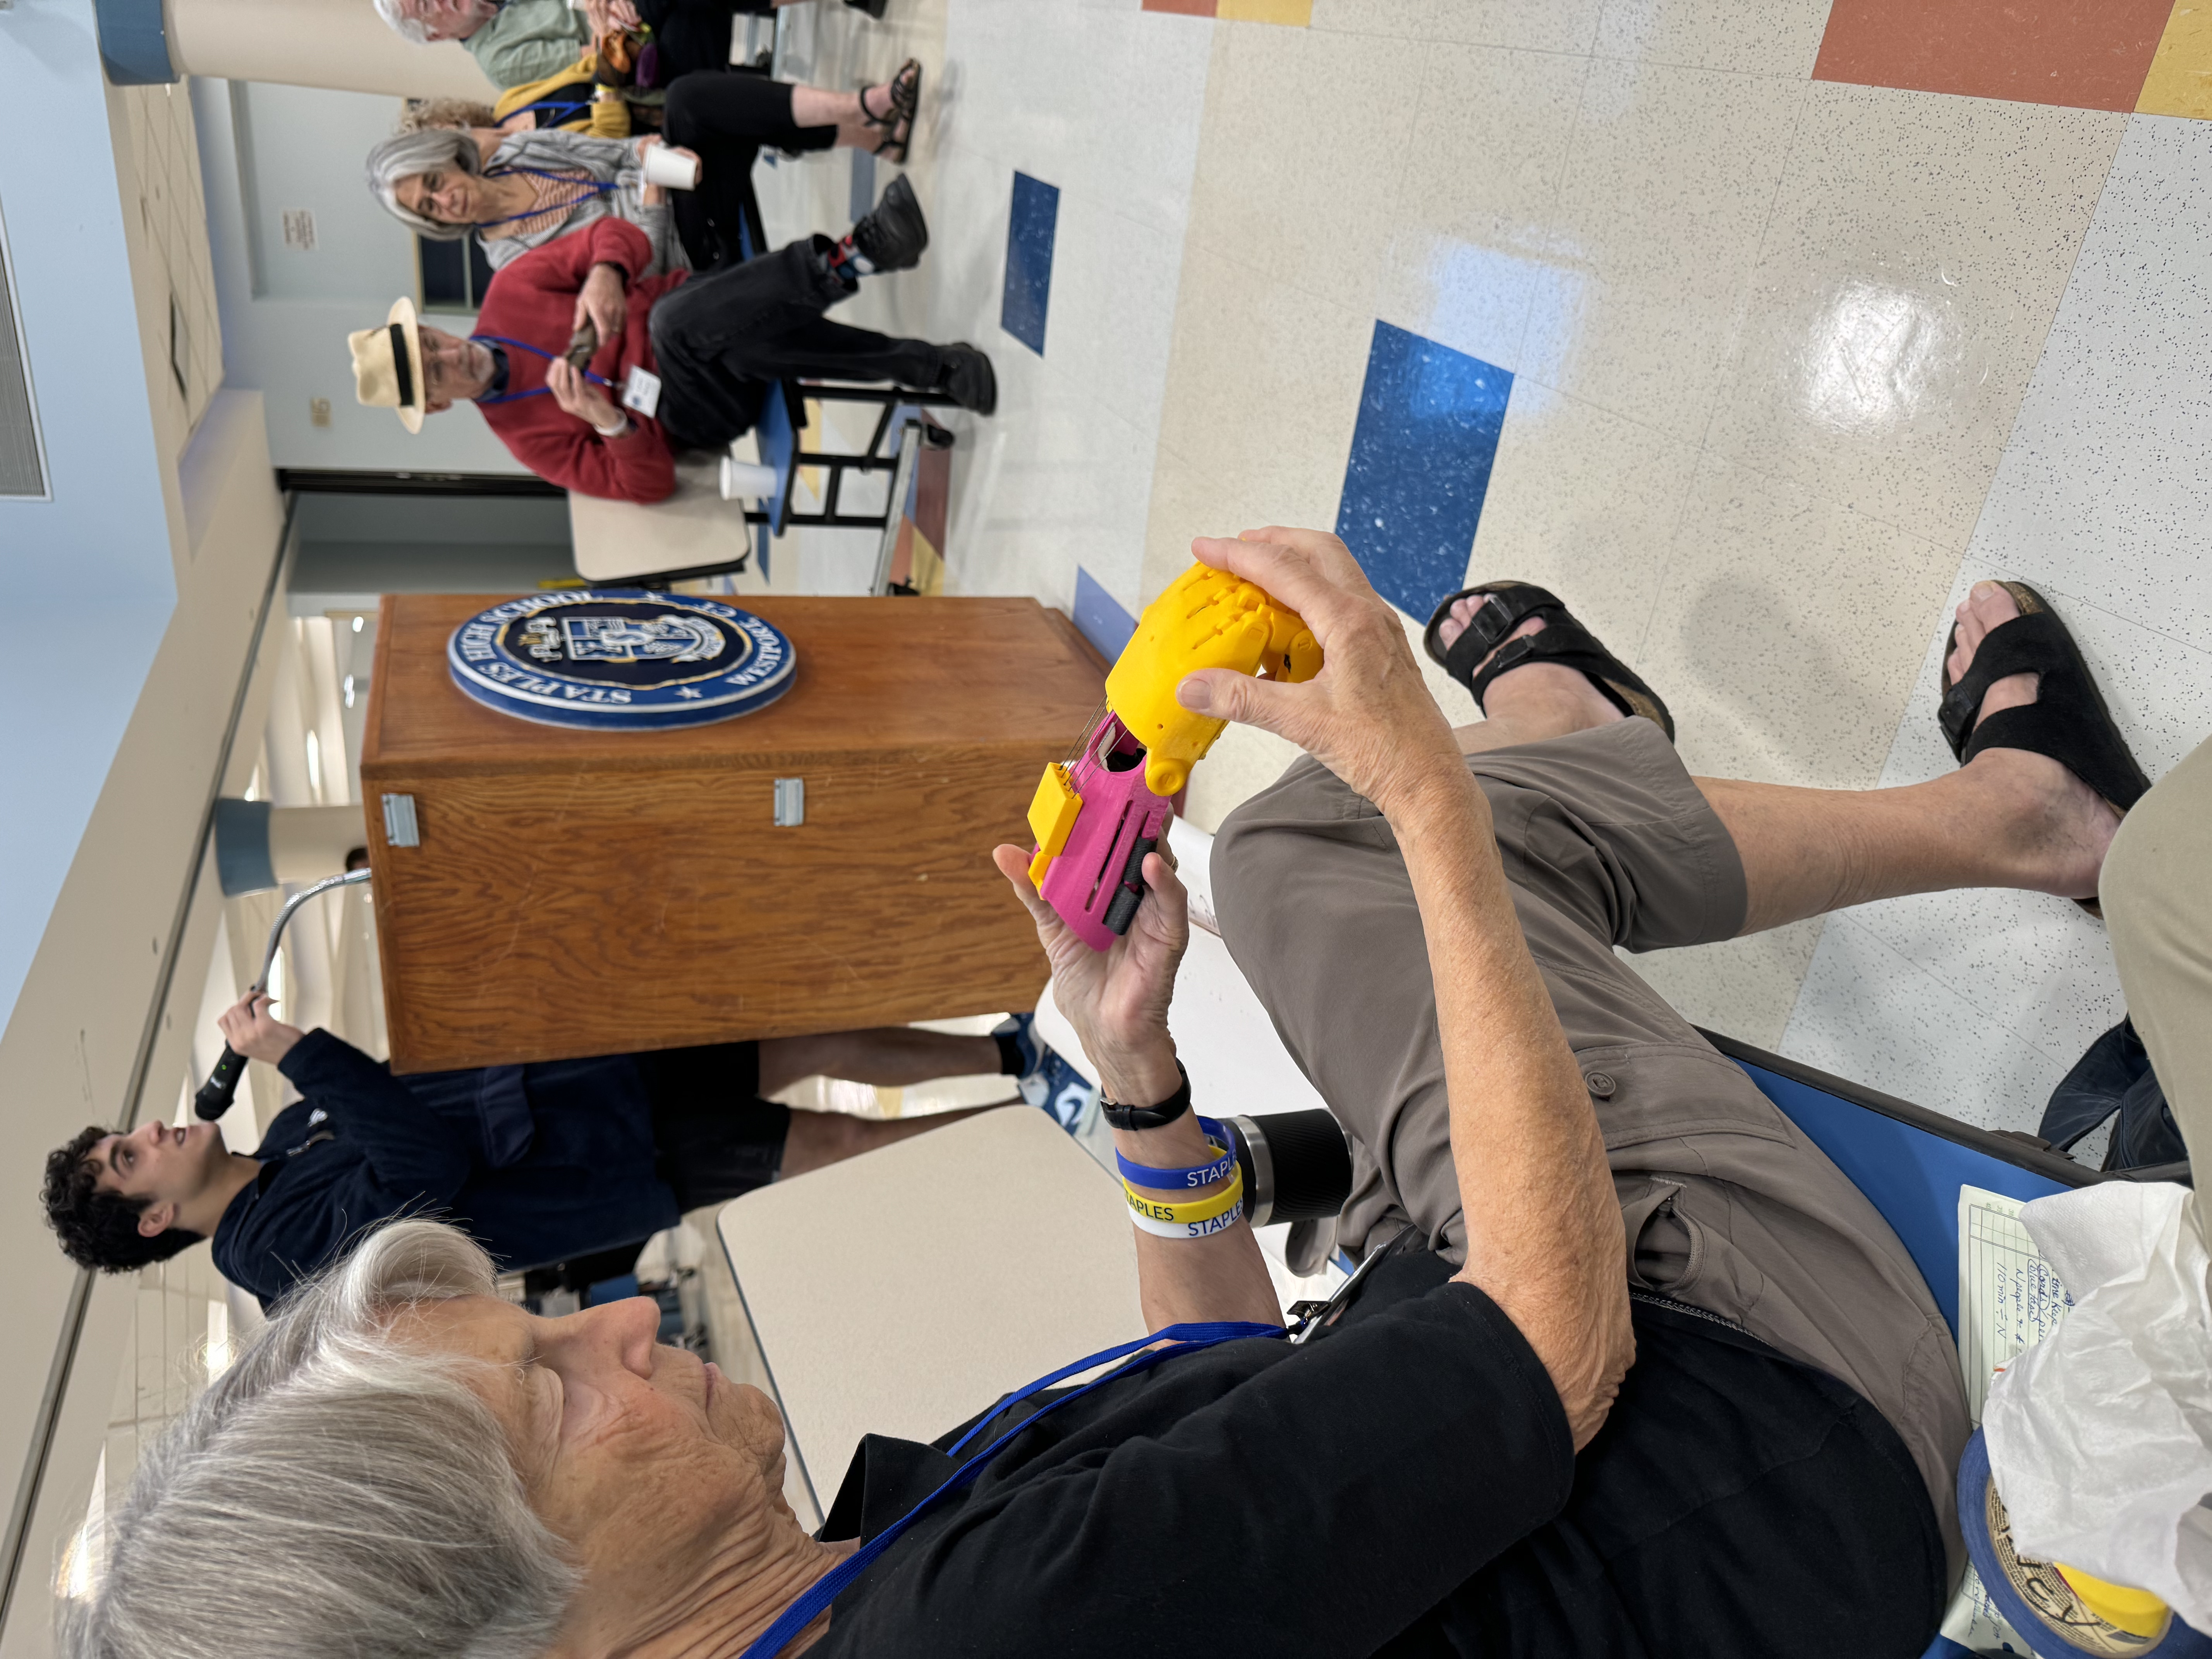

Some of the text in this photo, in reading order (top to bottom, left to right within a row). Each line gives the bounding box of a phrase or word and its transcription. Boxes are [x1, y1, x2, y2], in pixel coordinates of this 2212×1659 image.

[461, 590, 631, 704] STAPLES HIGH SCHOOL
[1187, 1149, 1237, 1187] STAPLE
[1124, 1187, 1174, 1221] TAPLES
[1996, 1262, 2007, 1283] 110
[1997, 1285, 2007, 1304] min
